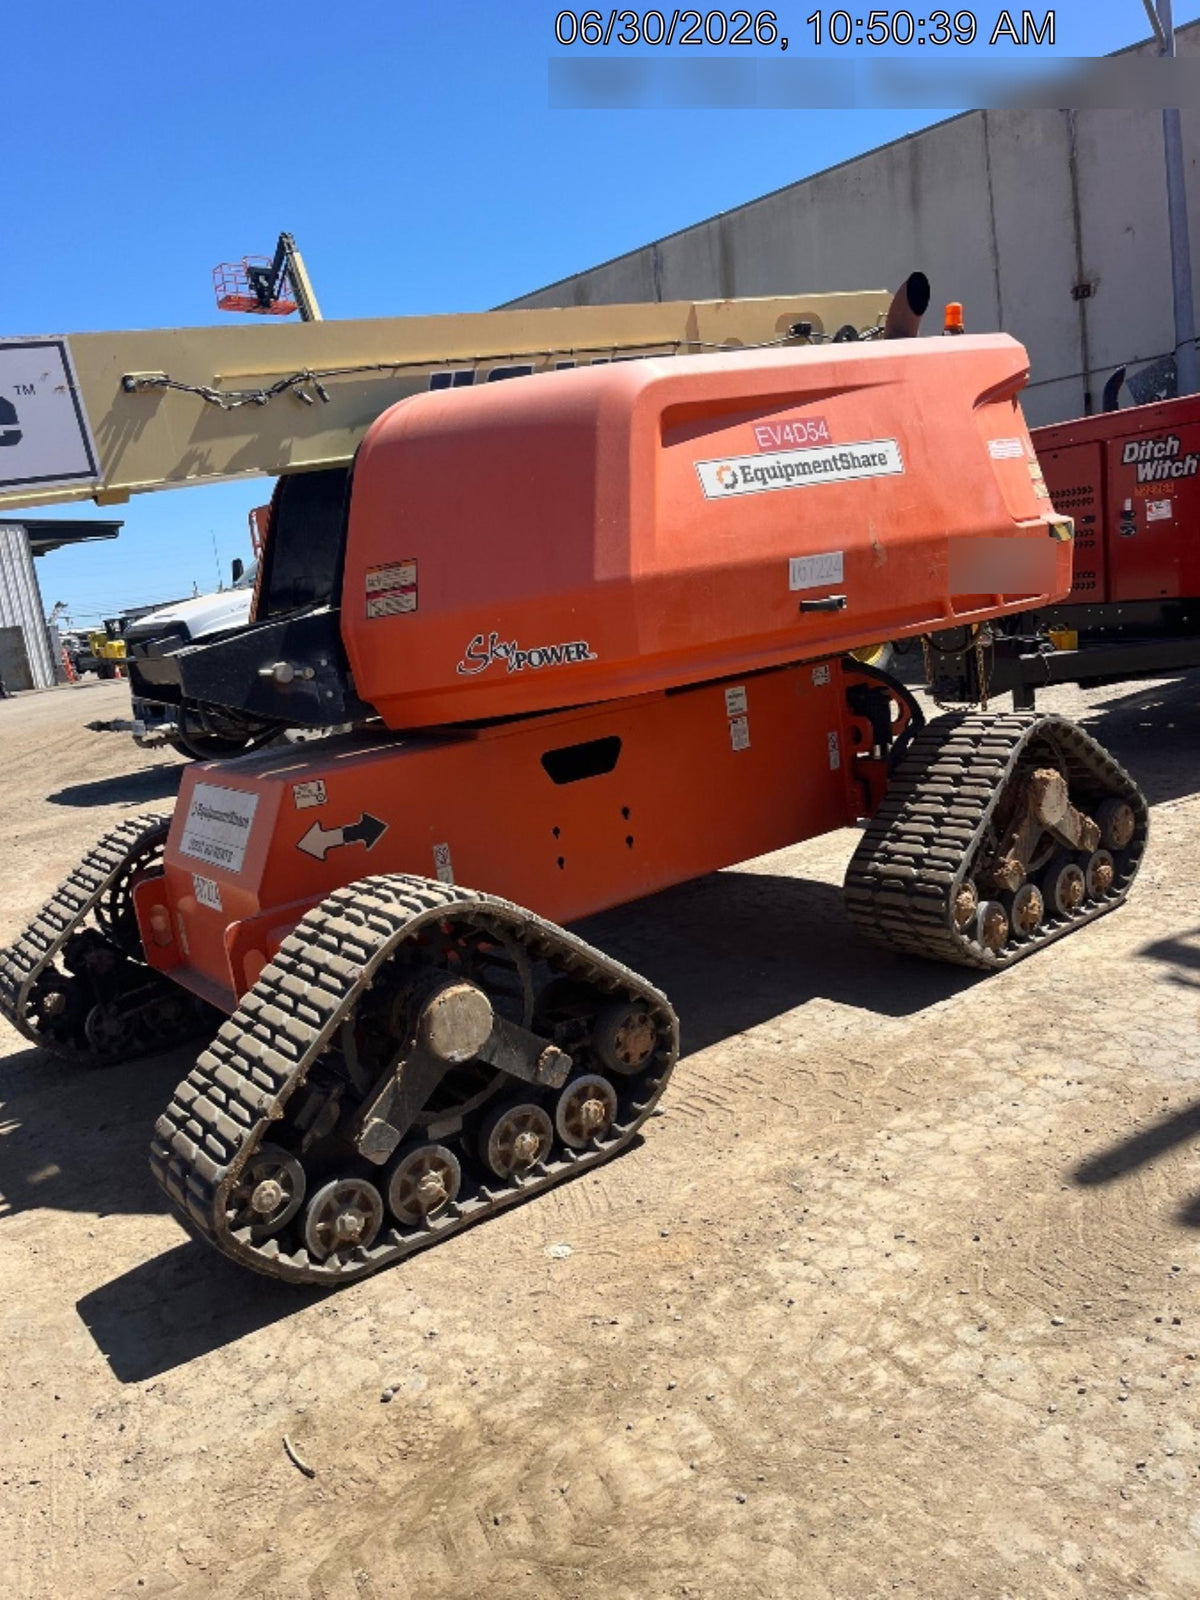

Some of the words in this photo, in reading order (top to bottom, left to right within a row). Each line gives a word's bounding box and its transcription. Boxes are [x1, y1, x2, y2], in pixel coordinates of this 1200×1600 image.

[755, 419, 830, 448] EV4D54
[1122, 435, 1181, 464] Ditch
[739, 451, 889, 486] EquipmentShare
[1136, 453, 1198, 483] Witch
